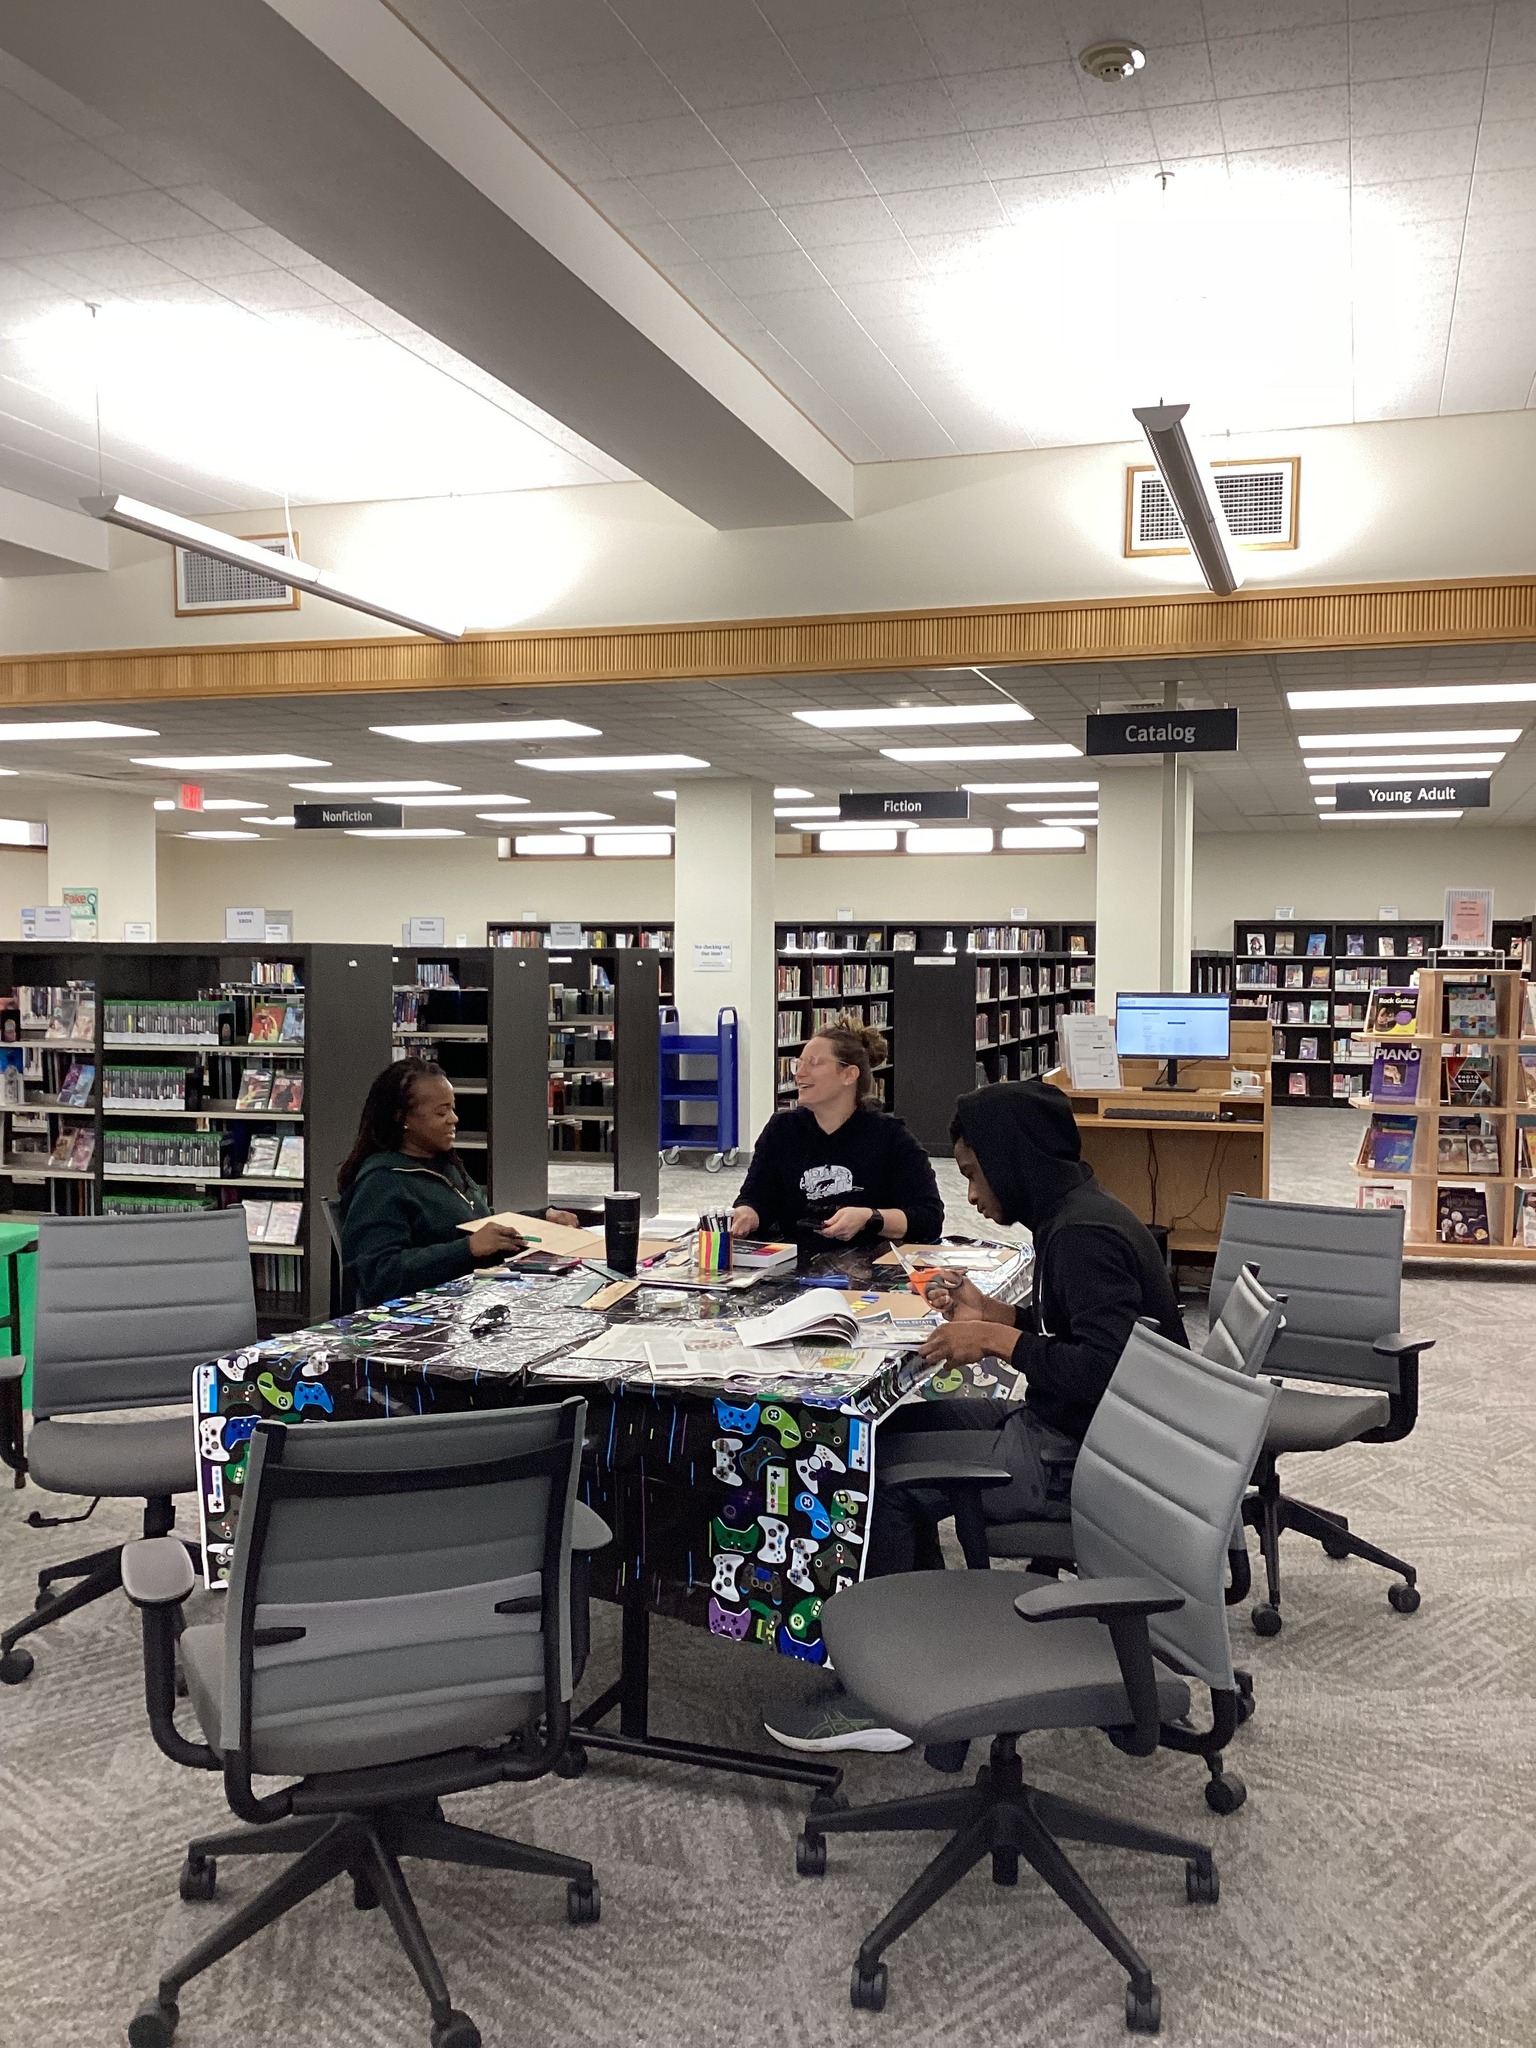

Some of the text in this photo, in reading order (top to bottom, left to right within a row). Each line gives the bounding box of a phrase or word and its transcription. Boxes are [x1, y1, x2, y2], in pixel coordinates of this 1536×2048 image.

[1125, 722, 1196, 743] Catalog
[182, 786, 202, 809] EXIT
[1368, 786, 1456, 804] Young Adult
[883, 800, 922, 812] Fiction
[322, 810, 373, 822] Nonfiction
[63, 893, 86, 904] Fake
[1375, 1048, 1420, 1061] PIANO
